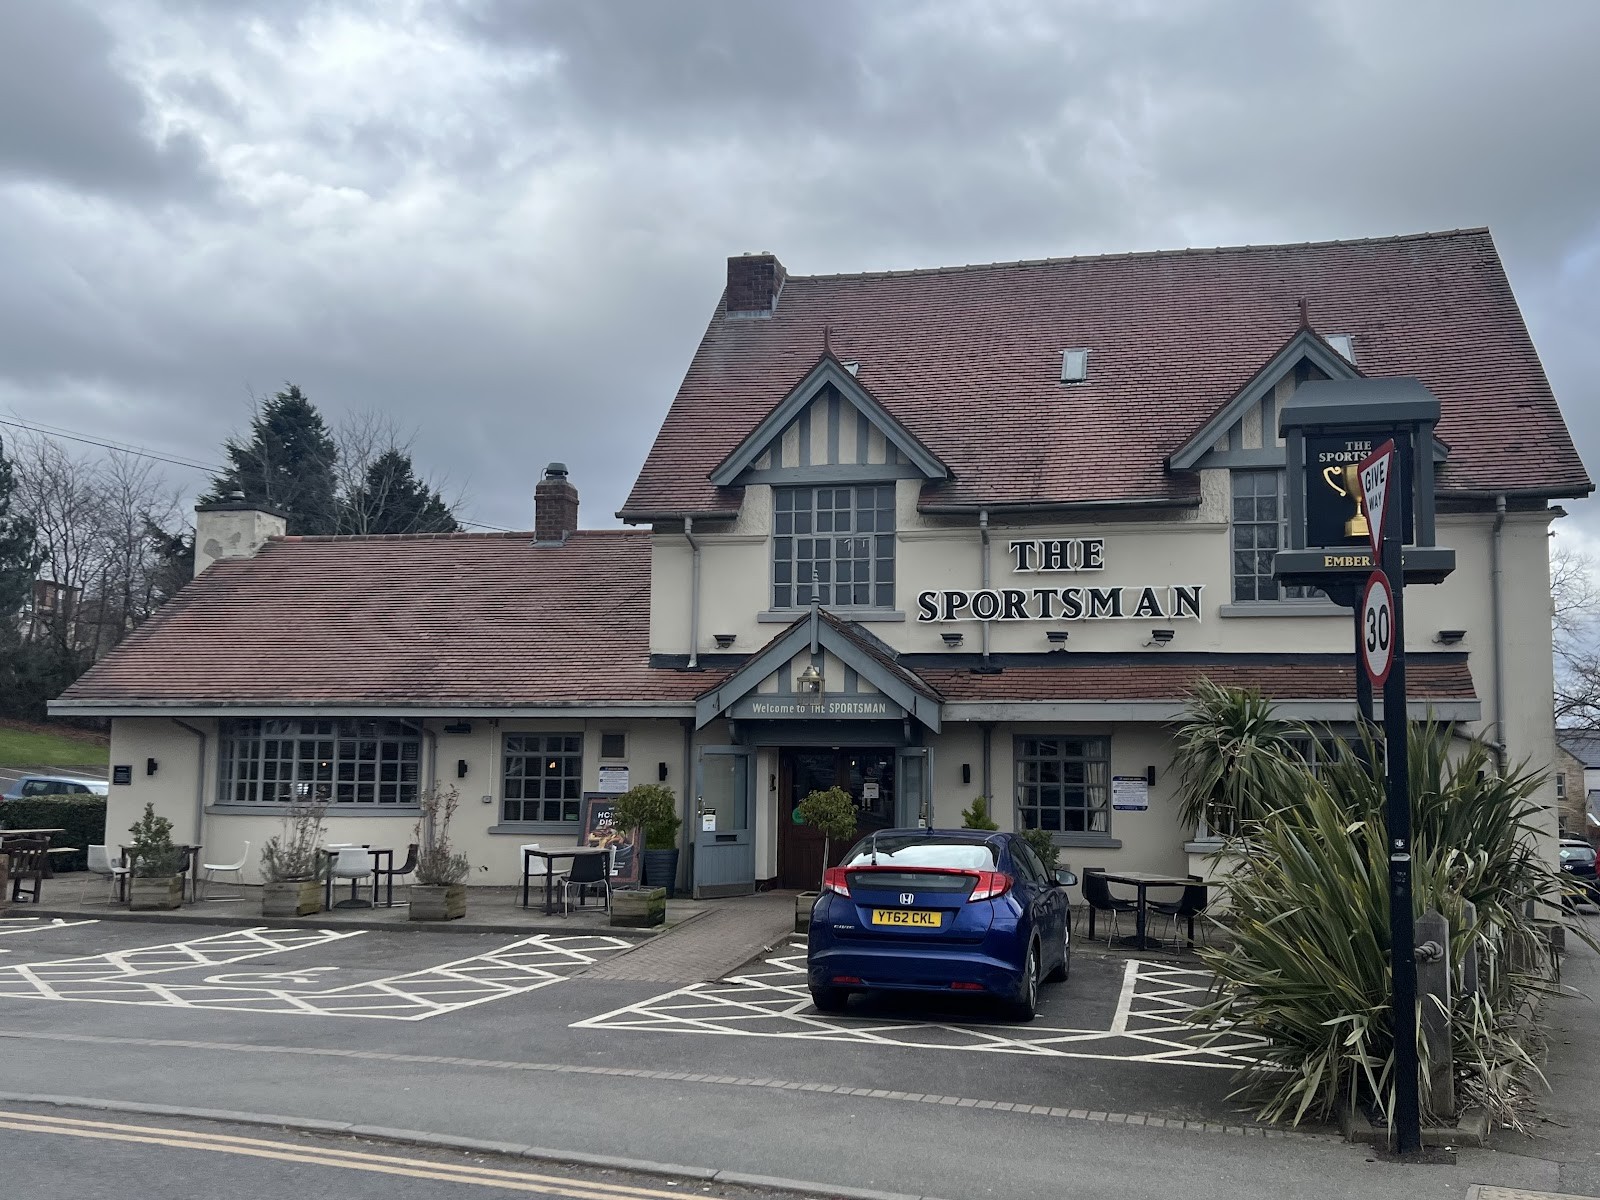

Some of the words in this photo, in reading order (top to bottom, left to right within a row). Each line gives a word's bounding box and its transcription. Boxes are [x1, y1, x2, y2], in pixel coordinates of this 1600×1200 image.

[1345, 441, 1371, 450] THE
[1365, 461, 1385, 493] GIVE
[1368, 491, 1382, 512] WAY
[1009, 538, 1105, 572] THE
[1324, 555, 1370, 567] EMBER
[917, 585, 1206, 623] SPORTSMAN
[1366, 606, 1389, 653] 30
[752, 703, 794, 713] Welcome
[797, 704, 805, 713] to
[811, 703, 825, 713] THE
[829, 702, 886, 713] SPORTSMAN
[878, 911, 908, 924] YT62
[912, 912, 935, 925] CKL
